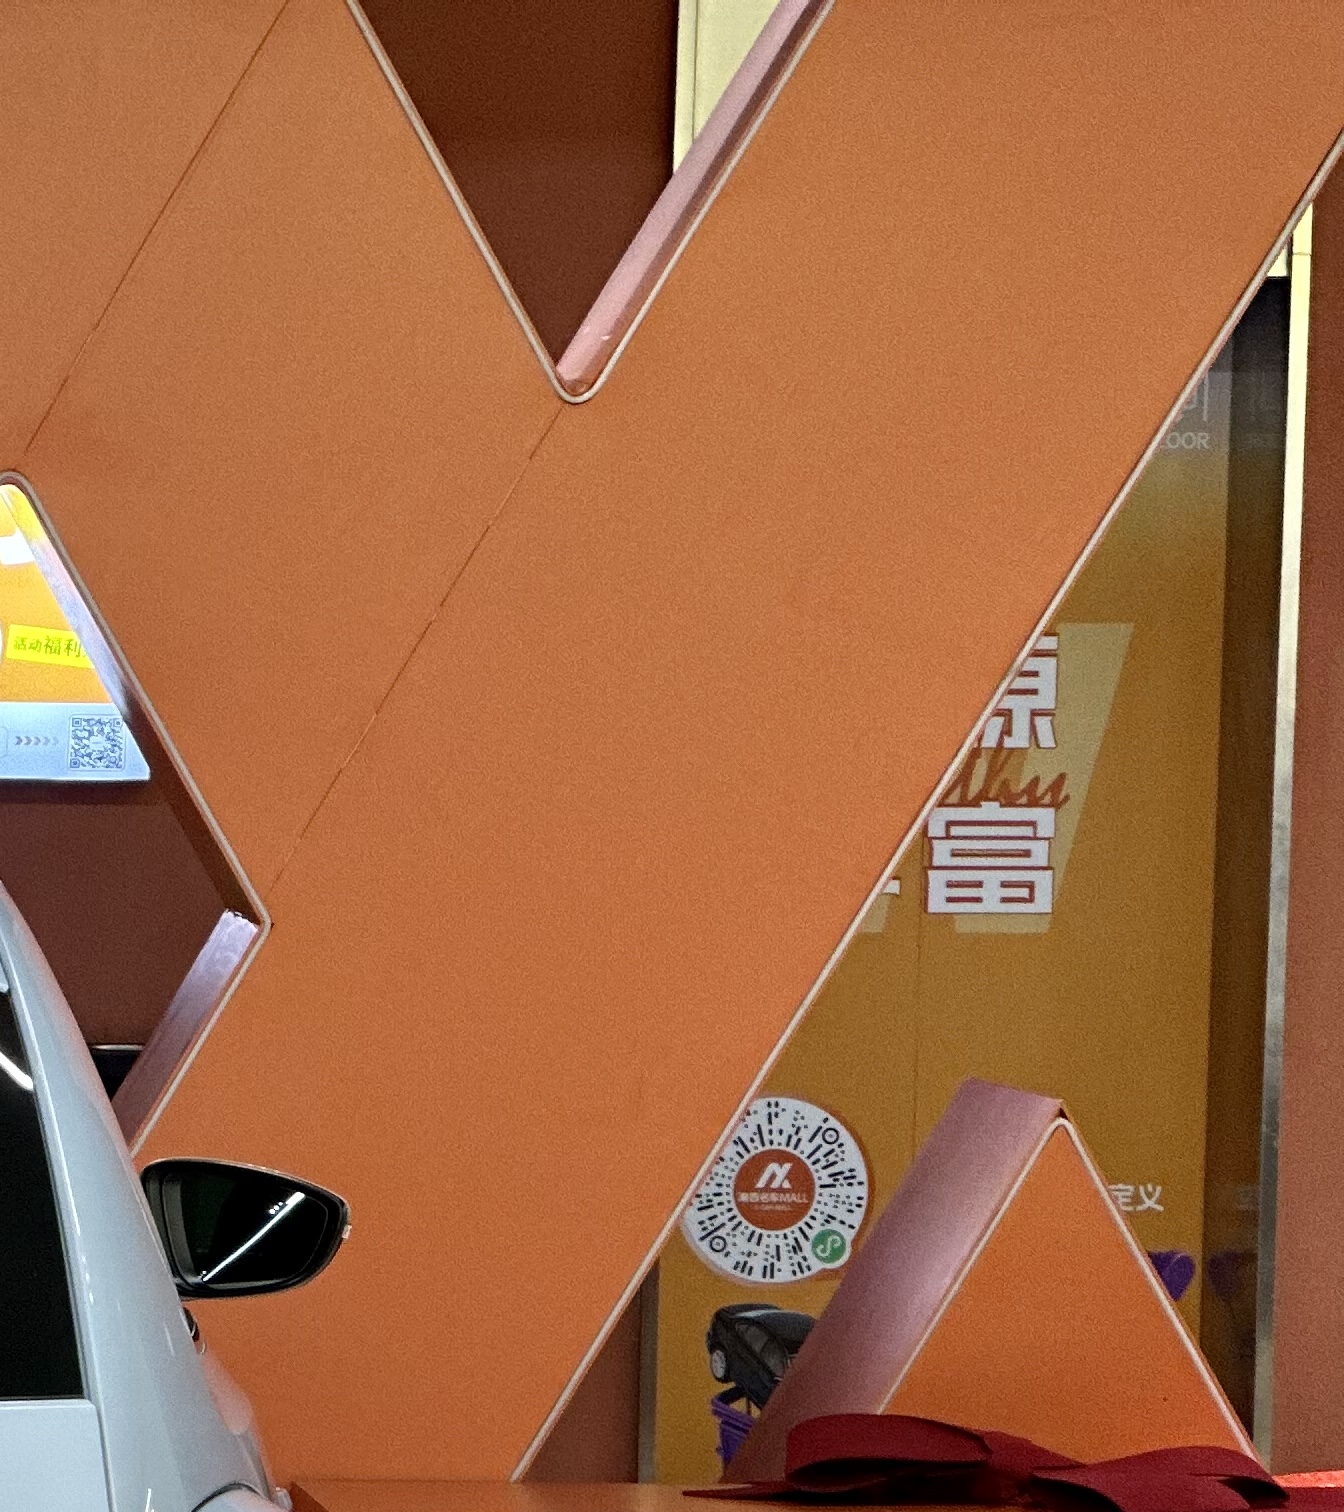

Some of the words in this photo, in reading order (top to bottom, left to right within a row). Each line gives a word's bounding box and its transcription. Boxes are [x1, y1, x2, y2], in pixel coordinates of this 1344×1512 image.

[1162, 431, 1210, 450] OOR
[13, 634, 88, 659] 活动福利
[882, 800, 1056, 913] 富
